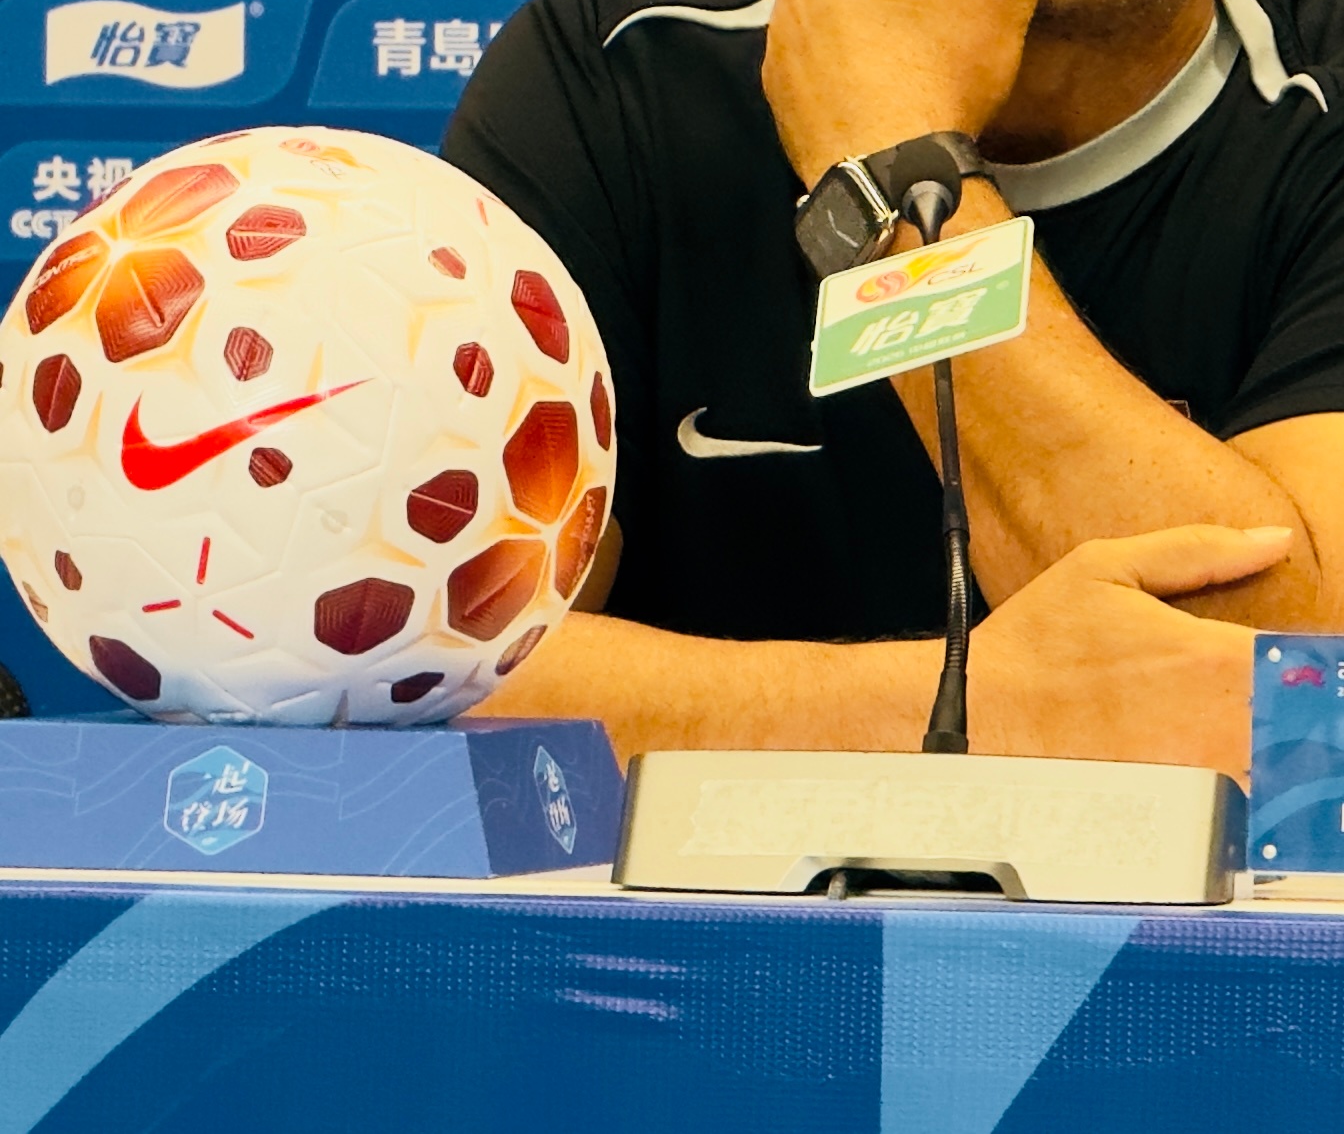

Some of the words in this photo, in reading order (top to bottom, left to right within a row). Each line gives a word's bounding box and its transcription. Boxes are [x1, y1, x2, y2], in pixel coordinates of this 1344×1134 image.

[90, 21, 201, 68] 怡寶
[372, 18, 504, 76] 青島
[32, 155, 134, 202] 央视
[10, 208, 80, 239] CCT
